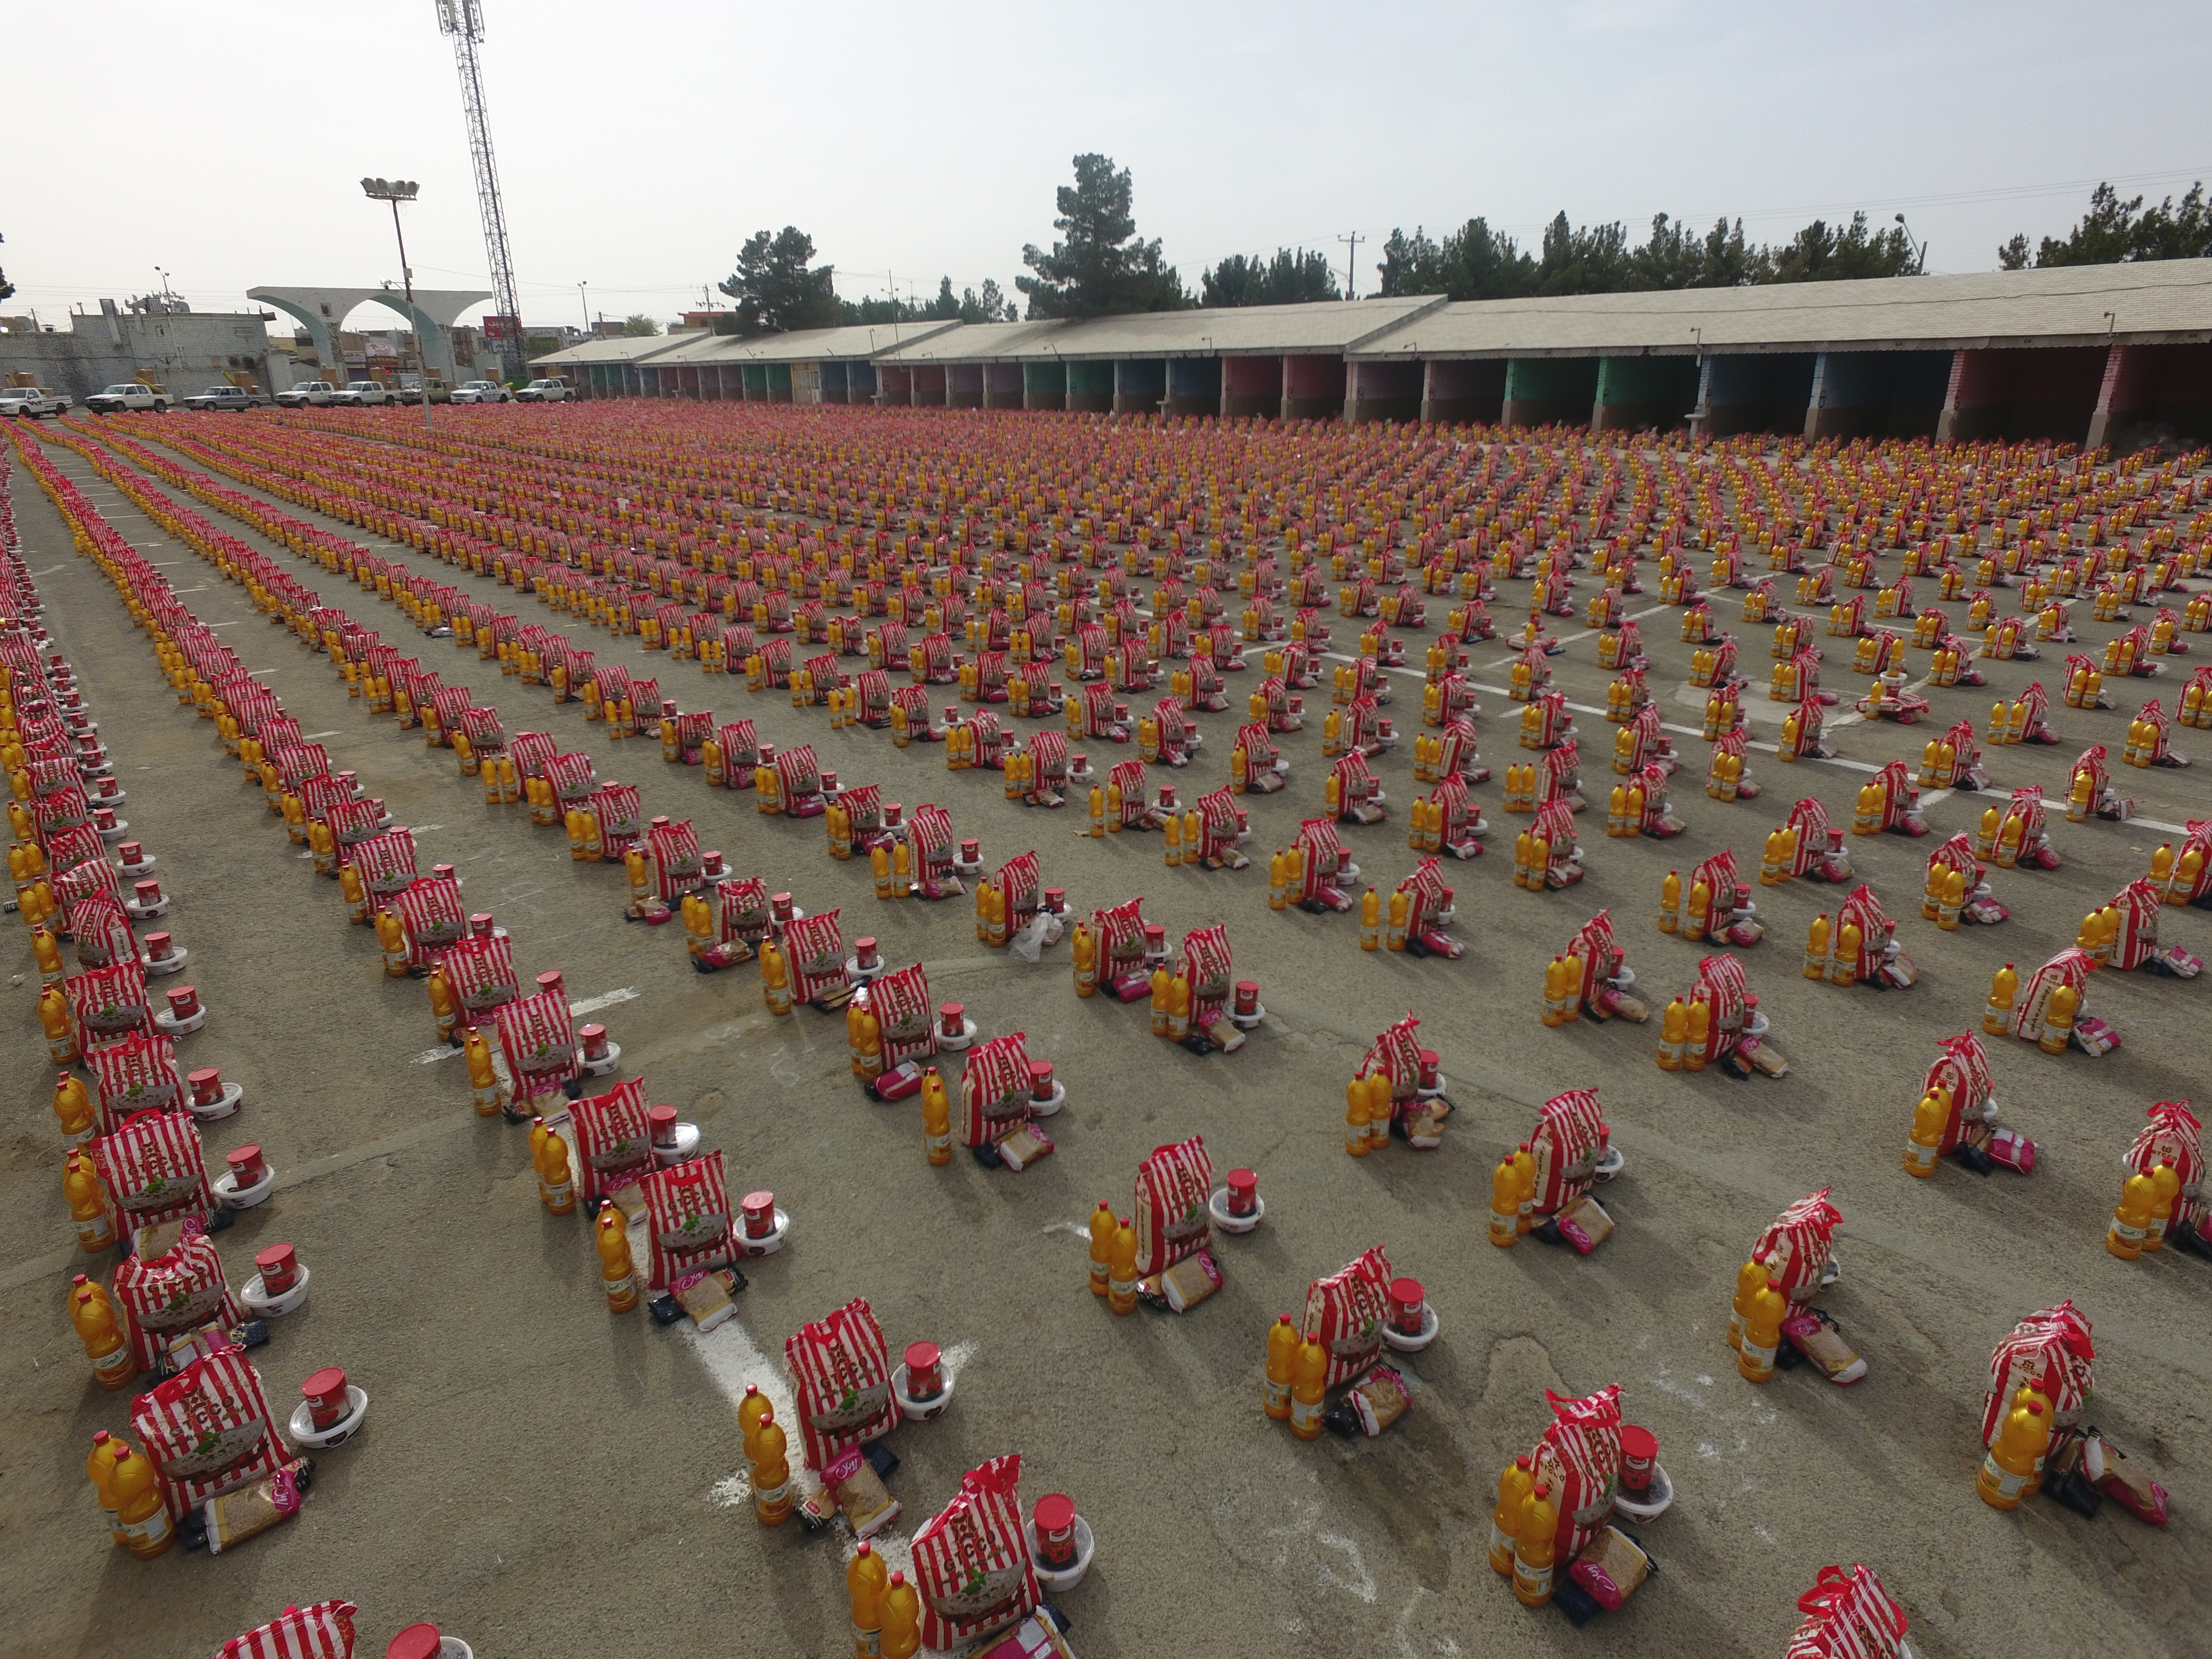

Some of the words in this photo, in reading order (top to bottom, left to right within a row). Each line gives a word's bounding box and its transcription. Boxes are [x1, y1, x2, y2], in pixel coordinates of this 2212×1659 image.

[467, 967, 502, 983] GTCCO
[89, 985, 128, 1001] GTCCO
[888, 994, 918, 1010] GTCCO
[523, 1024, 558, 1042] GTCCO
[113, 1064, 158, 1080] GTCCO
[599, 1114, 638, 1137] GTCCO
[128, 1152, 180, 1176] GTCCO
[2151, 1149, 2178, 1161] GTCCO
[667, 1188, 711, 1212] GTCCO
[819, 1355, 868, 1390] GTCCO
[2011, 1361, 2043, 1379] GTCCO
[169, 1395, 236, 1438] GTCCO
[1585, 1437, 1616, 1477] GTCCO
[943, 1529, 997, 1573] GTCCO
